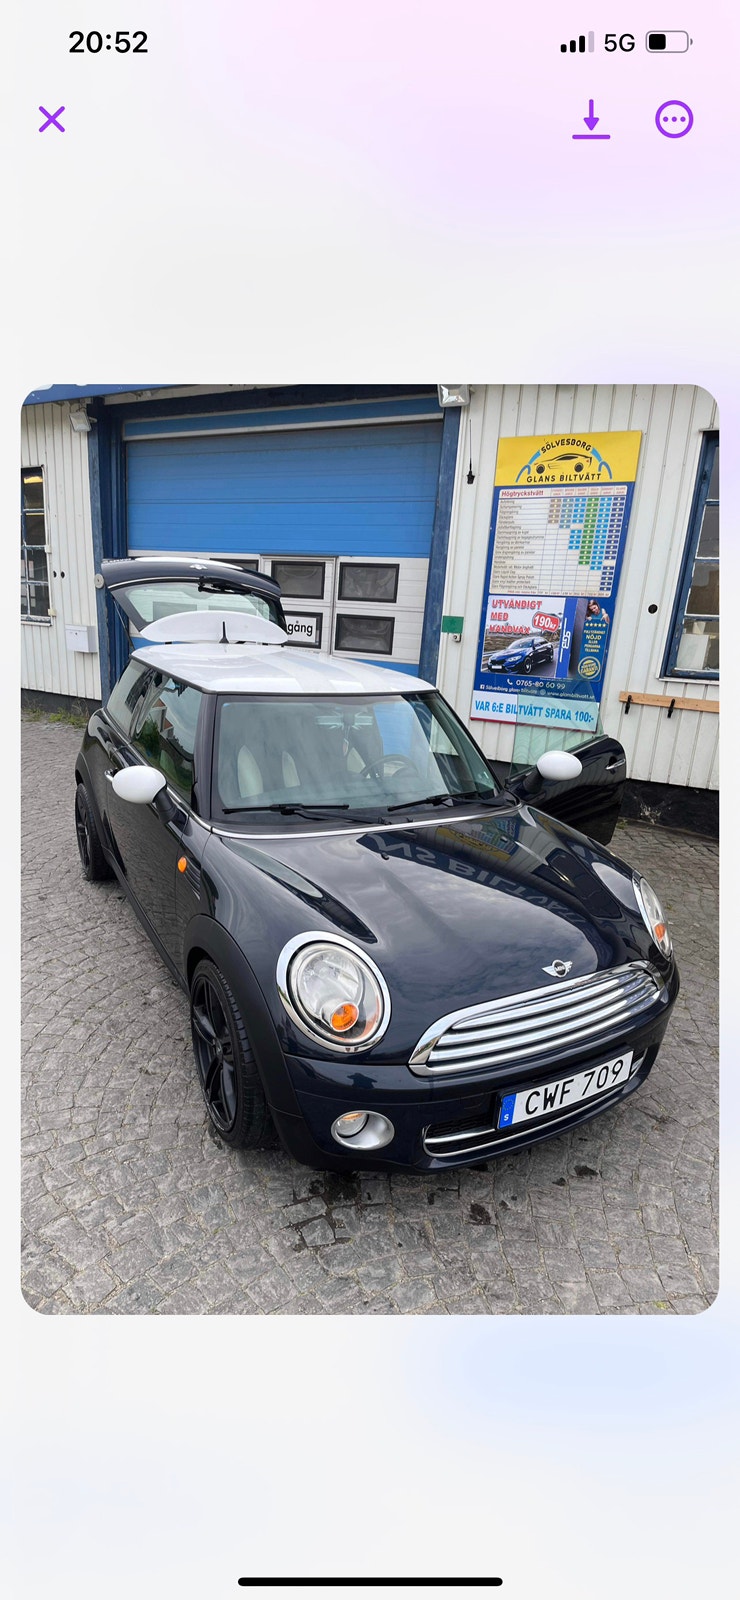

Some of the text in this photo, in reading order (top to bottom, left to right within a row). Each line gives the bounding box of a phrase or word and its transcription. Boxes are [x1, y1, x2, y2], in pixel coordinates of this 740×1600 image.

[541, 438, 592, 454] SÖLVESBORG
[526, 472, 602, 483] GLANS BILTVÄTT
[491, 599, 542, 610] UTVÄNDIGT
[490, 612, 509, 621] MED
[545, 681, 556, 689] 60
[556, 682, 566, 690] 99
[475, 700, 490, 712] VAR
[491, 701, 504, 713] 6:E
[505, 703, 543, 717] BILTVÄTT
[545, 708, 572, 721] SPARA
[525, 1078, 575, 1115] CWF
[581, 1059, 624, 1096] 709
